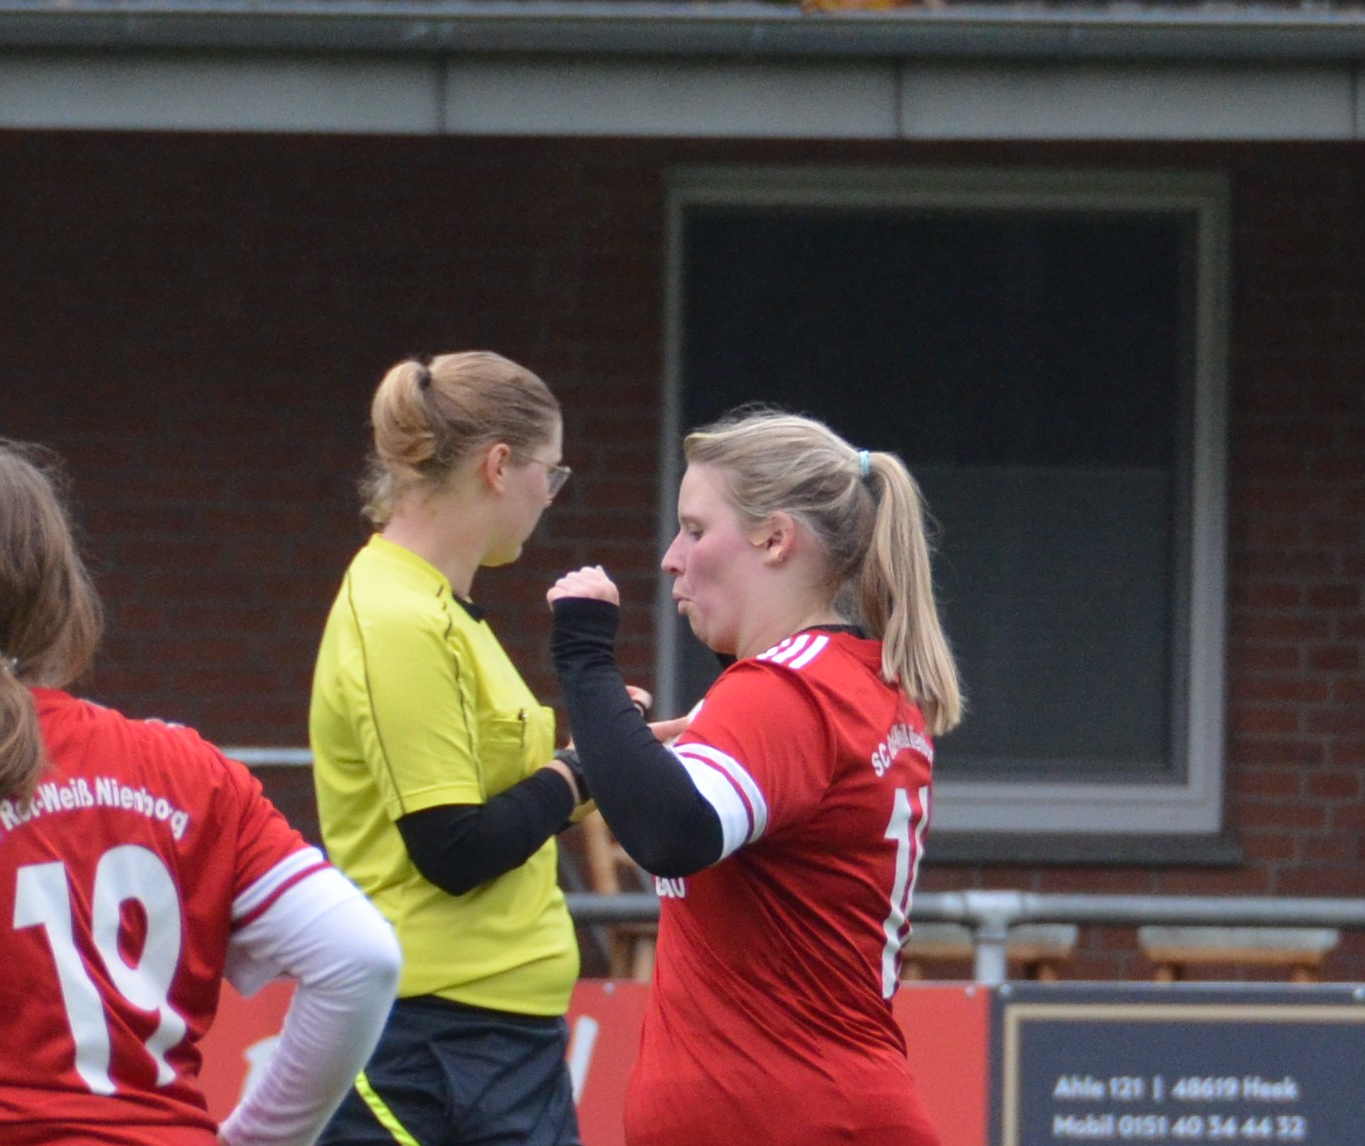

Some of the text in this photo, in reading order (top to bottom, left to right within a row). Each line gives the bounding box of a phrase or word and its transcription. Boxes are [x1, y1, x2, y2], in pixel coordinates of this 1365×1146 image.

[95, 776, 190, 841] Nienbog
[12, 844, 187, 1096] 19
[1053, 1075, 1105, 1099] Ahle
[1109, 1076, 1144, 1099] 121
[1171, 1076, 1239, 1099] 48619
[1242, 1075, 1299, 1099] Heek
[1053, 1114, 1115, 1137] Mobil
[1119, 1115, 1169, 1138] 0151
[1171, 1115, 1204, 1138] 40
[1240, 1115, 1273, 1138] 44
[1276, 1115, 1307, 1138] 32
